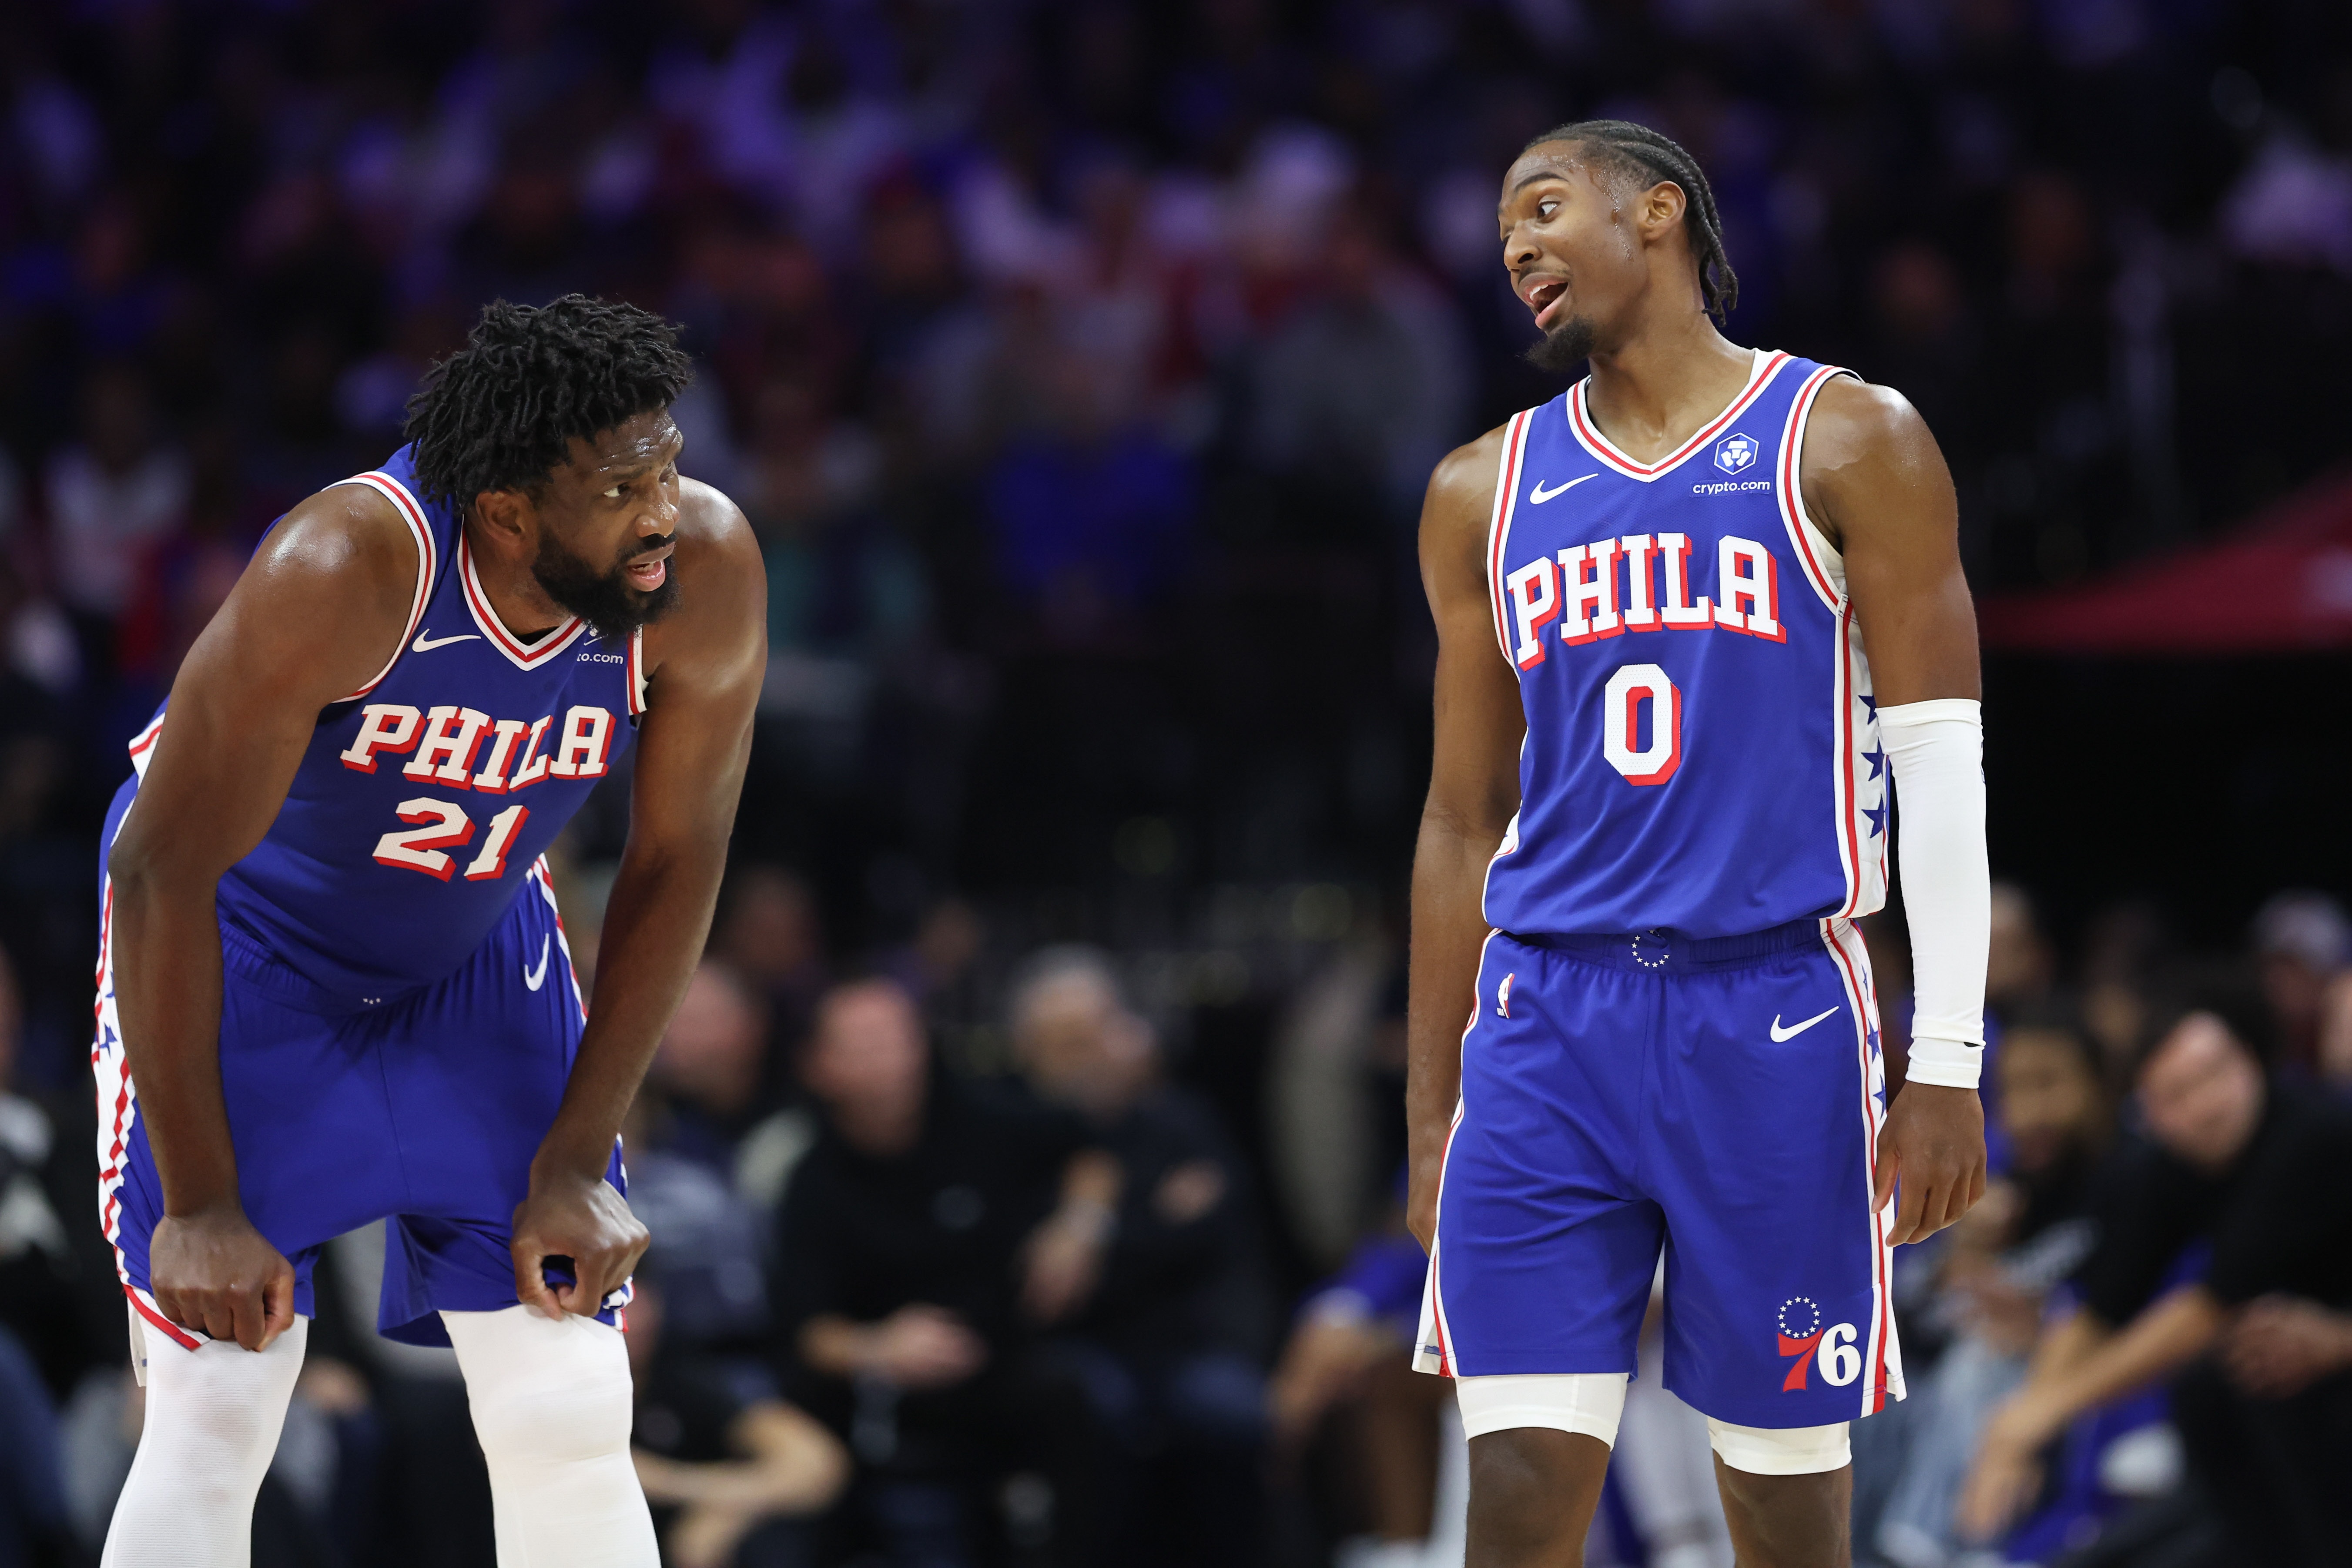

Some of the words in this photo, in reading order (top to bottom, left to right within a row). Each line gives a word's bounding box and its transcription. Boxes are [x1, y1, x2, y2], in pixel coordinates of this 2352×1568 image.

[1693, 481, 1770, 495] crypto.com
[1507, 533, 1786, 671] PHILA
[340, 704, 616, 795] PHILA
[1604, 664, 1681, 786] 0
[372, 797, 530, 882] 21
[1778, 1323, 1861, 1392] 76
